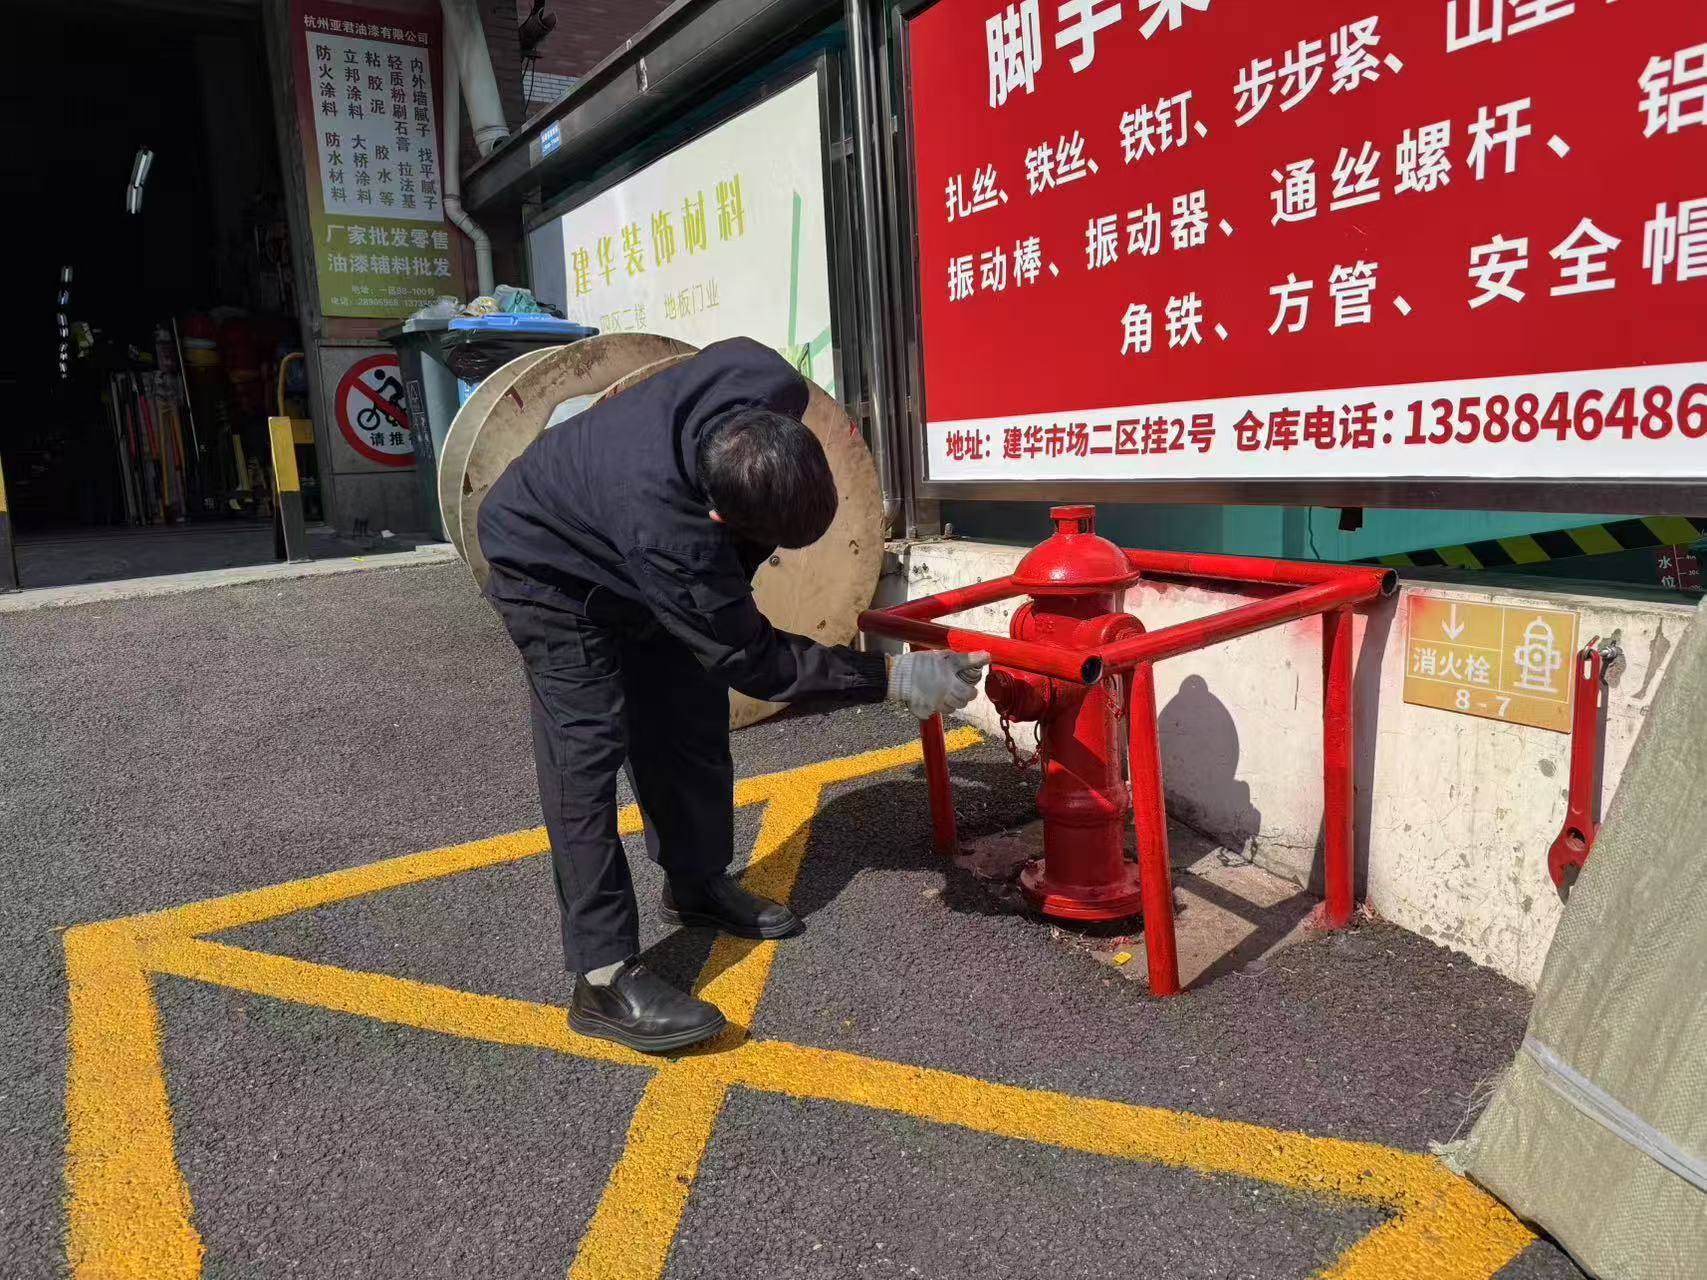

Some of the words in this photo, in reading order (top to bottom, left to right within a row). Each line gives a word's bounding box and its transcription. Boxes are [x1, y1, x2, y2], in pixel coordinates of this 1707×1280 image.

[316, 45, 338, 117] 防火涂料
[343, 49, 364, 120] 立邦涂料
[387, 54, 410, 152] 轻质粉刷石膏
[410, 57, 430, 137] 内外墙腻子
[365, 51, 385, 114] 粘胶泥
[375, 145, 394, 206] 胶水等
[945, 163, 1008, 222] 扎丝、
[1024, 130, 1099, 196] 铁丝、
[1119, 90, 1208, 165] 铁钉、
[1233, 16, 1404, 127] 步步紧、
[325, 132, 347, 202] 防水材料
[352, 134, 372, 204] 大桥涂料
[398, 162, 416, 209] 拉法基
[418, 148, 438, 210] 找平腻子
[947, 236, 1059, 302] 振动棒、
[1085, 189, 1233, 271] 振动器、
[1271, 97, 1571, 227] 通丝螺杆、
[327, 225, 448, 250] 厂家批发零售
[328, 253, 451, 277] 油漆辅料批发
[571, 174, 744, 297] 建华装饰材料
[664, 278, 719, 320] 地板门业
[1120, 292, 1228, 356] 角铁、
[1267, 260, 1411, 335] 方管、
[1467, 197, 1707, 309] 安全帽
[1413, 647, 1490, 684] 消火栓
